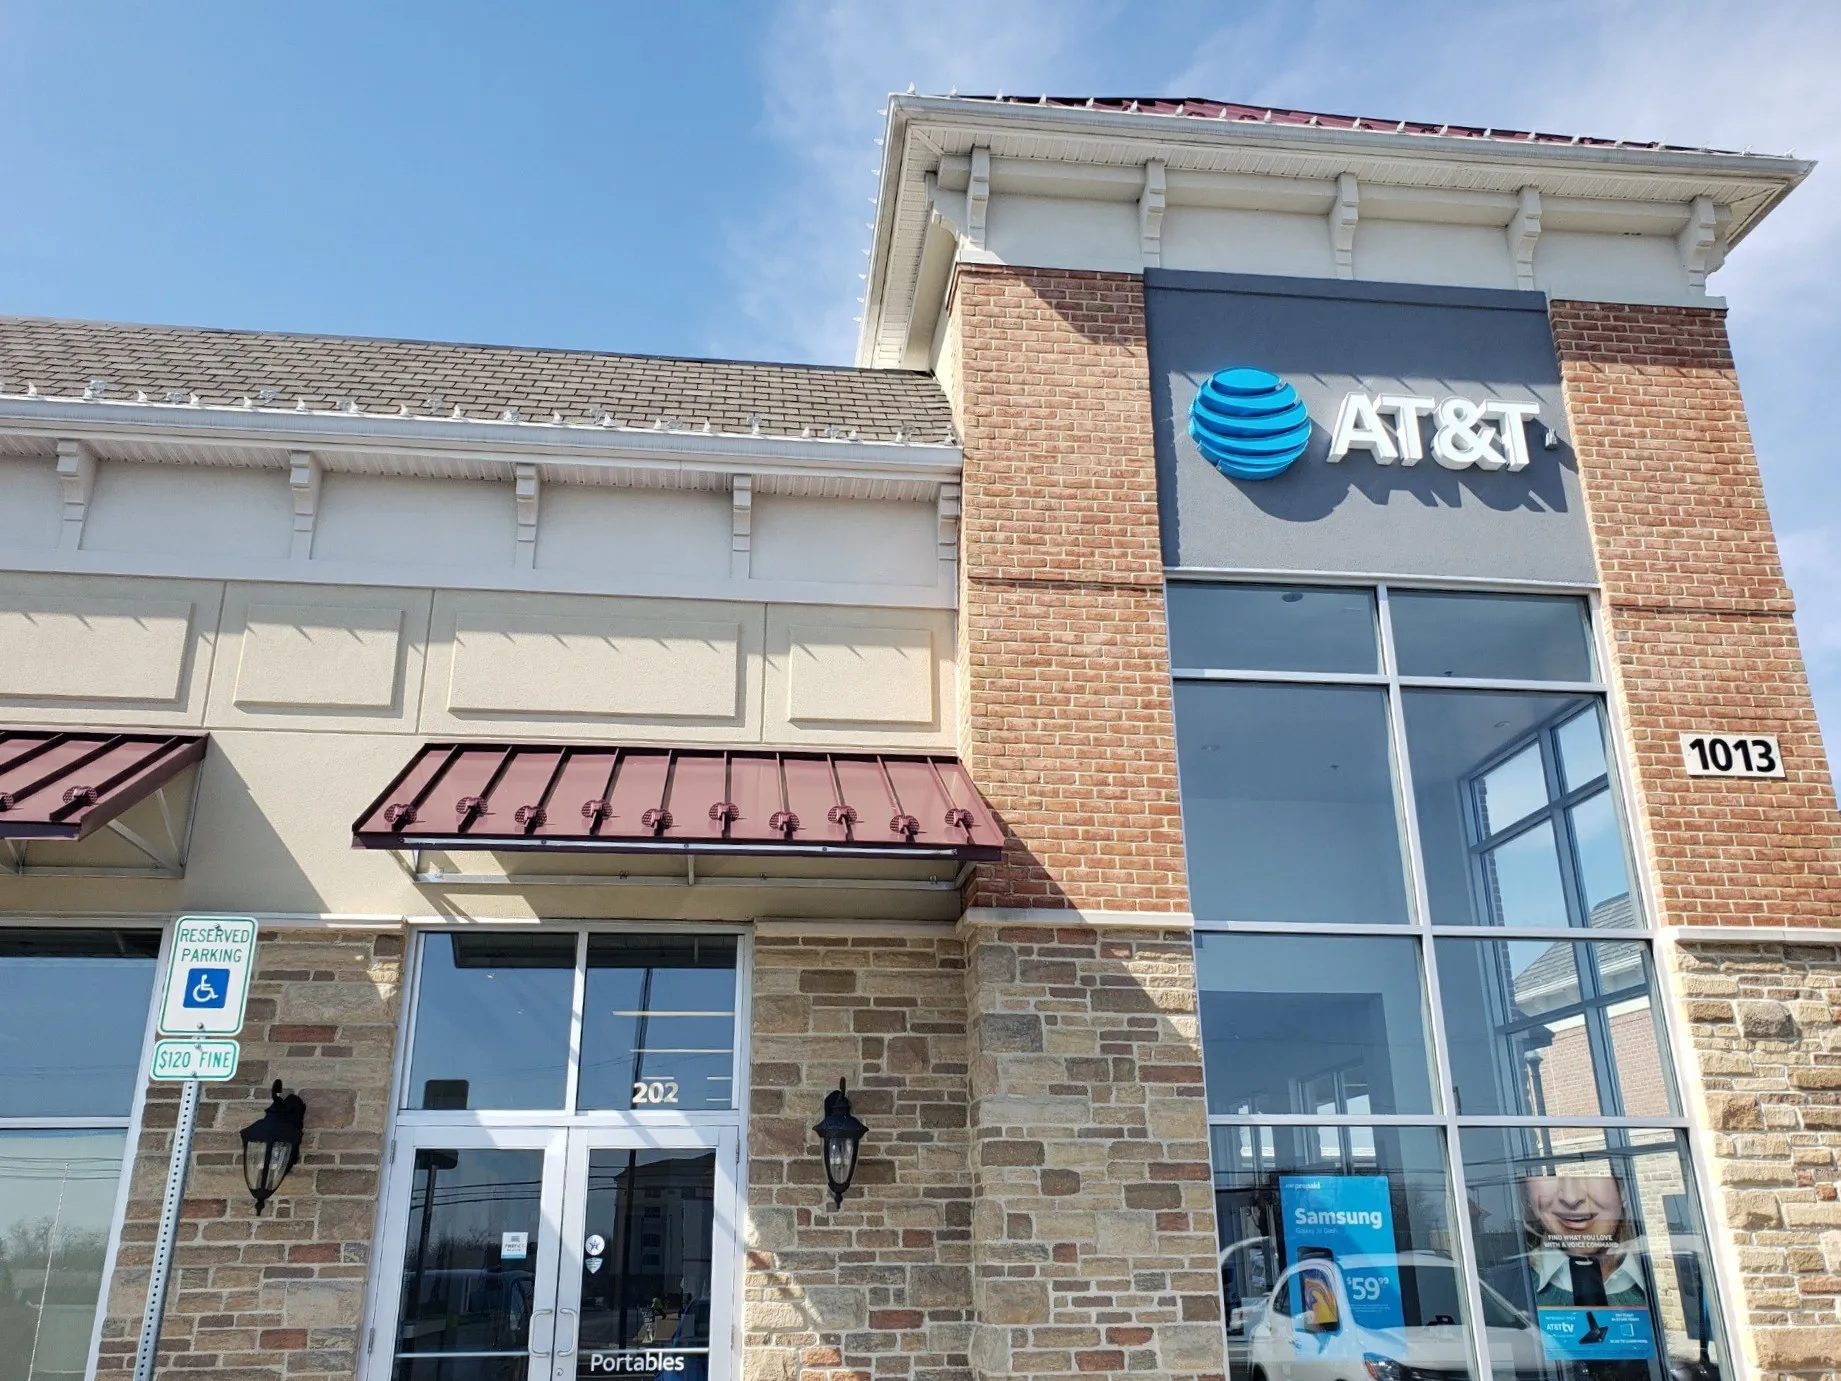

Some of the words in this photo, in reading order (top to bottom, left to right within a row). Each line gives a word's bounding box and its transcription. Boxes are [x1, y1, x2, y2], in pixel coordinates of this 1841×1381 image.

[1326, 392, 1540, 471] AT&T
[1689, 738, 1776, 772] 1013
[180, 928, 250, 944] RESERVED
[181, 948, 243, 963] PARKING
[159, 1051, 191, 1070] $120
[199, 1052, 231, 1069] FINE
[632, 1082, 679, 1104] 202
[1295, 1207, 1383, 1229] Samsung
[590, 1352, 685, 1372] Portables
